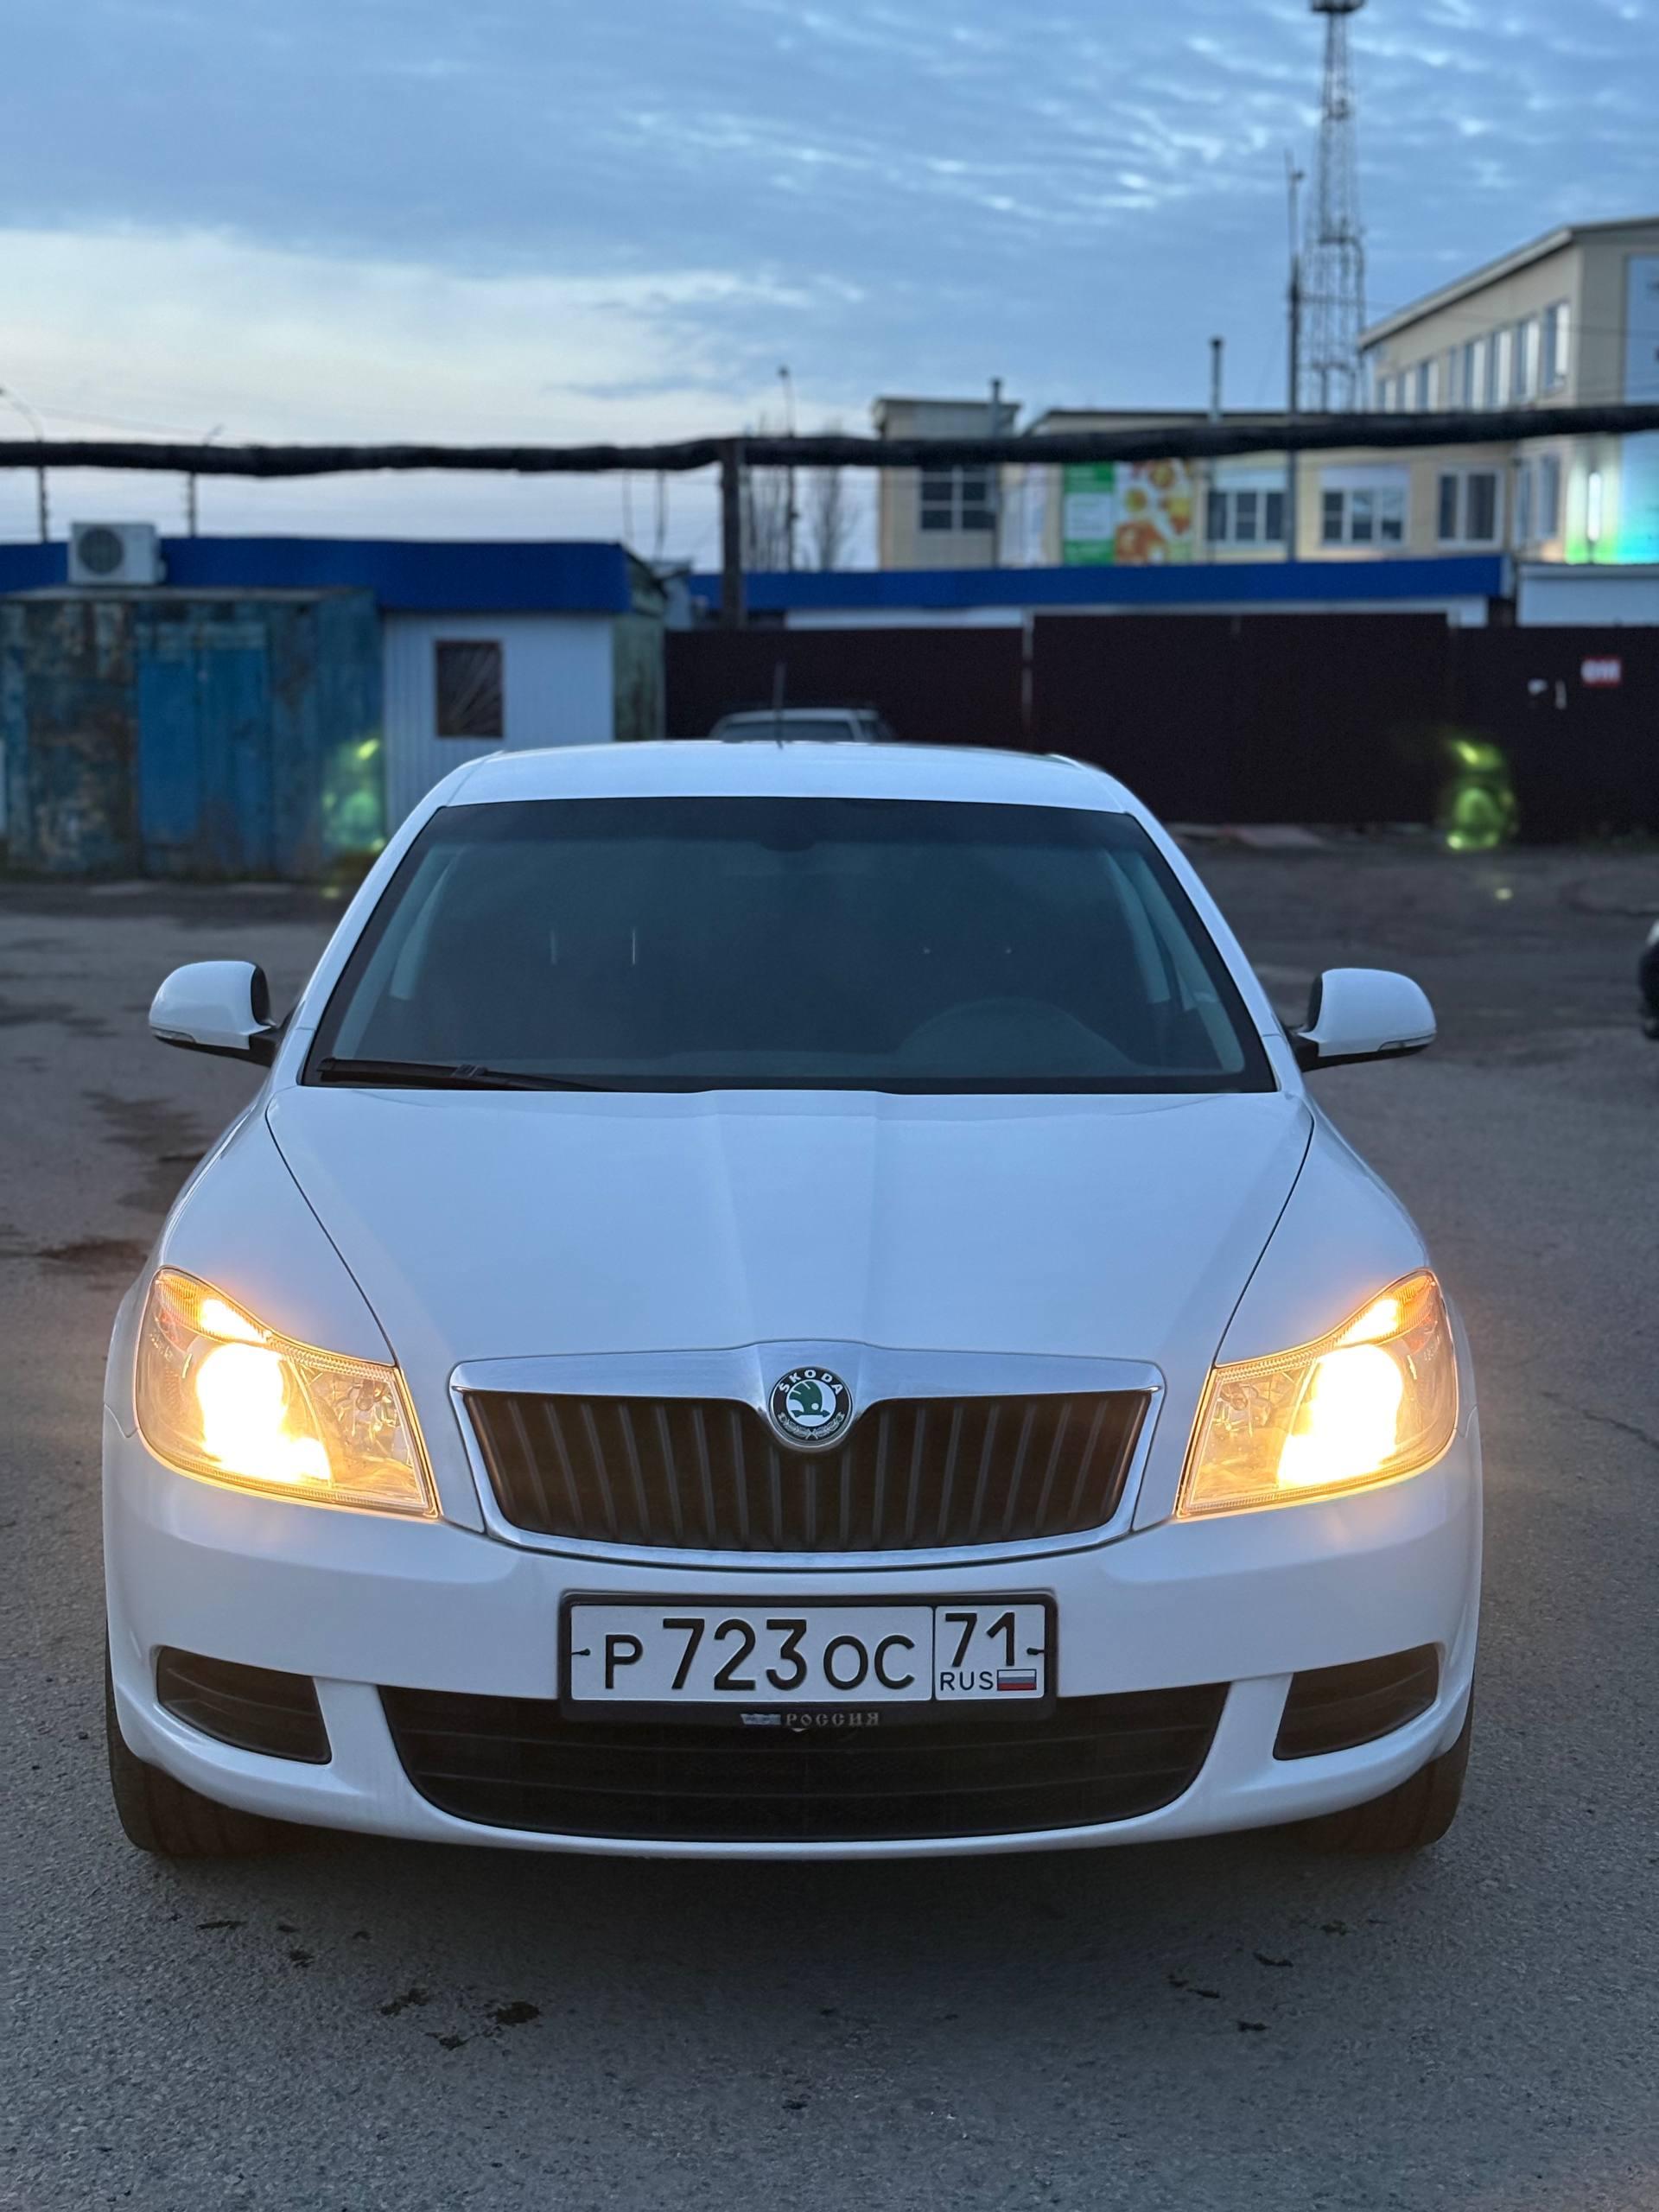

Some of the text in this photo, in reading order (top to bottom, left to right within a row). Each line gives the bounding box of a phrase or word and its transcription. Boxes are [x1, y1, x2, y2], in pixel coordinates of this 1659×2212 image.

[778, 1369, 844, 1395] SKODA
[944, 1611, 1015, 1668] 71
[939, 1670, 994, 1691] RUS
[785, 1713, 880, 1726] РОССИЯ
